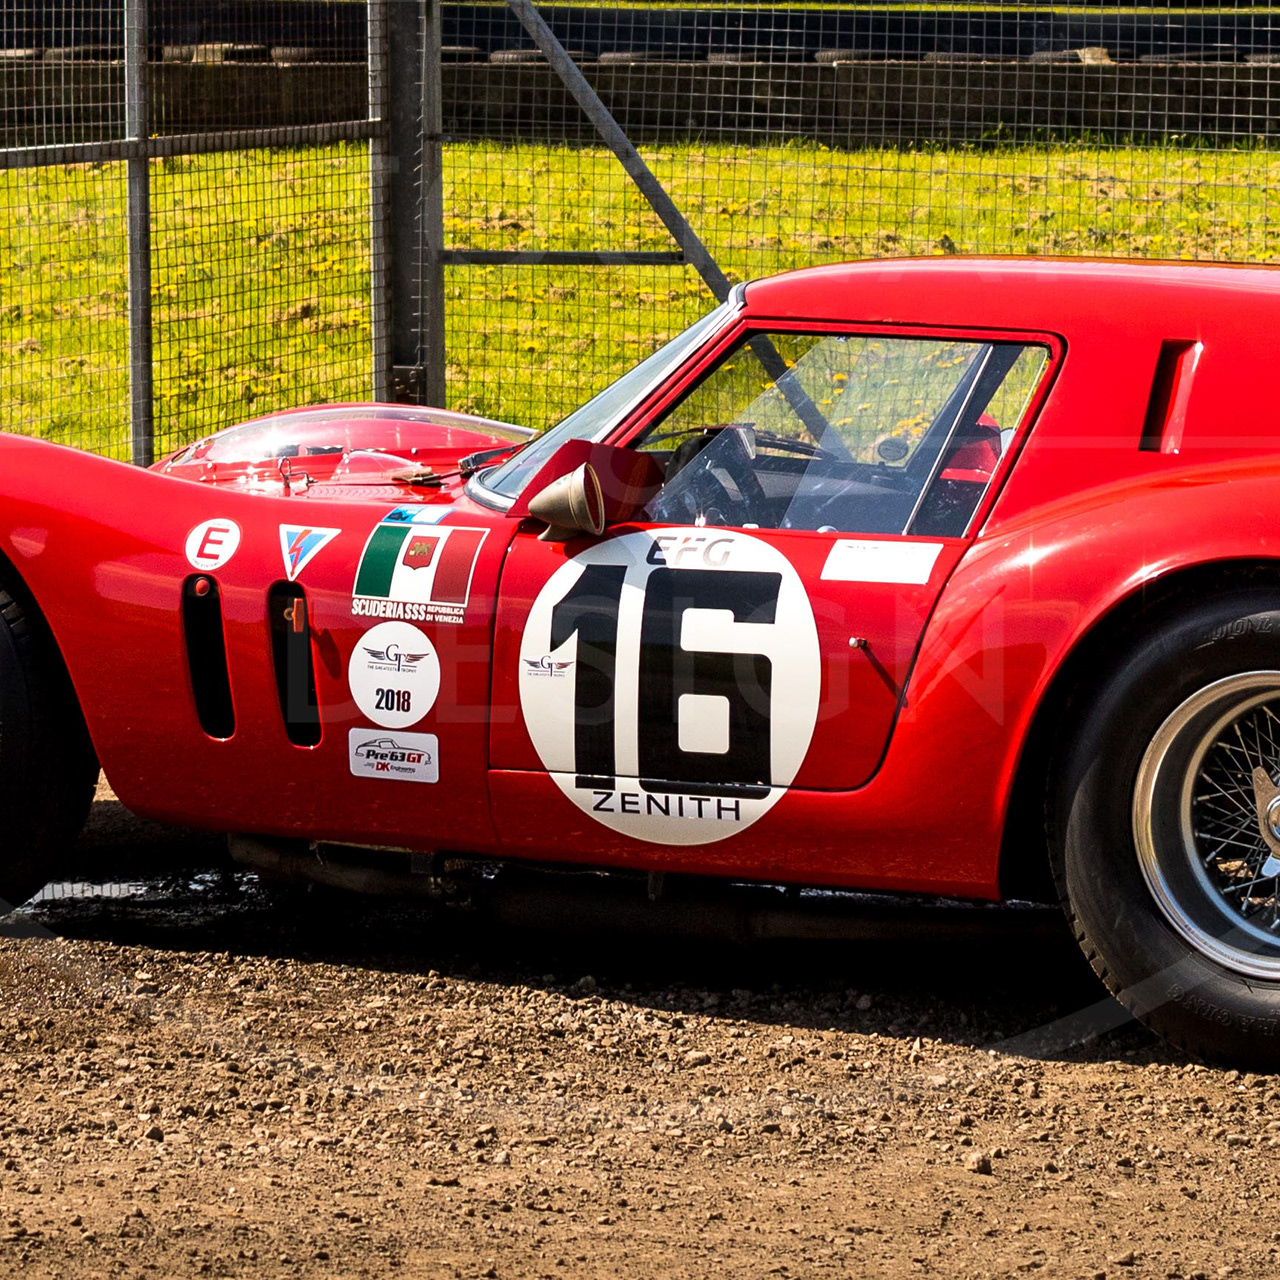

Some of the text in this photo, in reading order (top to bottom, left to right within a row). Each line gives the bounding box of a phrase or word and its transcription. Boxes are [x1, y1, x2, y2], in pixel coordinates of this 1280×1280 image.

[196, 526, 230, 560] E
[645, 535, 735, 567] EFG
[351, 598, 426, 621] SCUDERIA SSS
[426, 605, 464, 615] REPUBBLICA
[434, 615, 464, 624] VENEZIA
[549, 564, 782, 800] 16
[375, 688, 411, 712] 2018
[375, 761, 390, 772] DK
[592, 790, 741, 821] ZENITH
